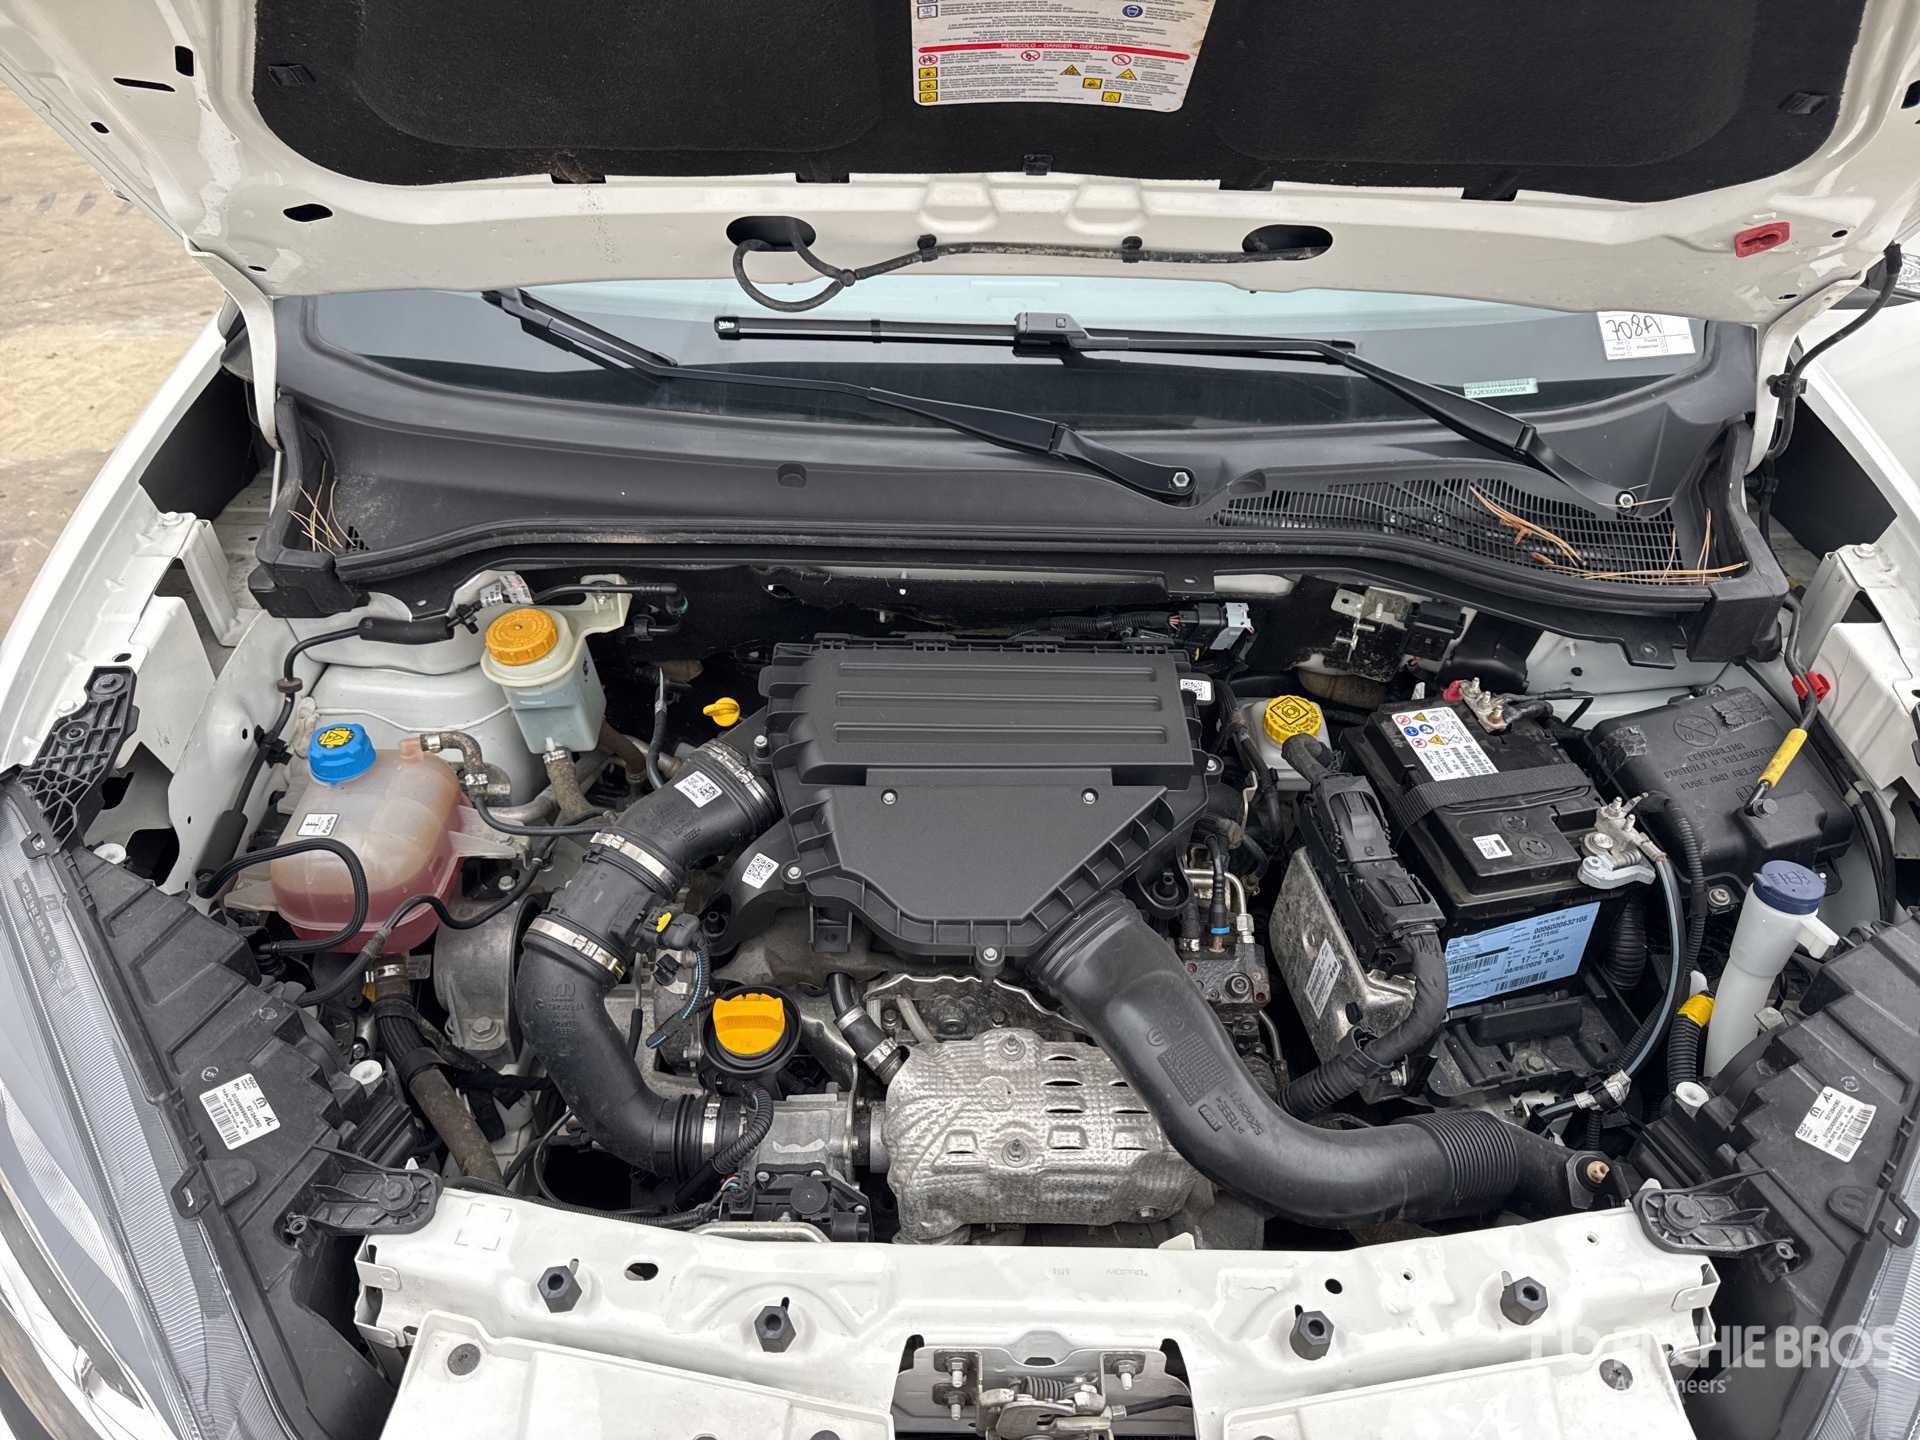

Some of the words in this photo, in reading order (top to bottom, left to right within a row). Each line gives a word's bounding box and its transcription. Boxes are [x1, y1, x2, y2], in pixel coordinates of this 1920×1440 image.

[1605, 314, 1662, 340] 708A
[1687, 743, 1746, 762] CENTRALINA
[1680, 778, 1707, 790] FUSE
[1710, 772, 1729, 784] AND
[1532, 930, 1559, 940] BATTERIE
[1504, 960, 1542, 974] 08/09/2026
[1545, 954, 1565, 964] 05:30
[233, 1082, 241, 1090] RH
[1811, 1134, 1819, 1143] LH
